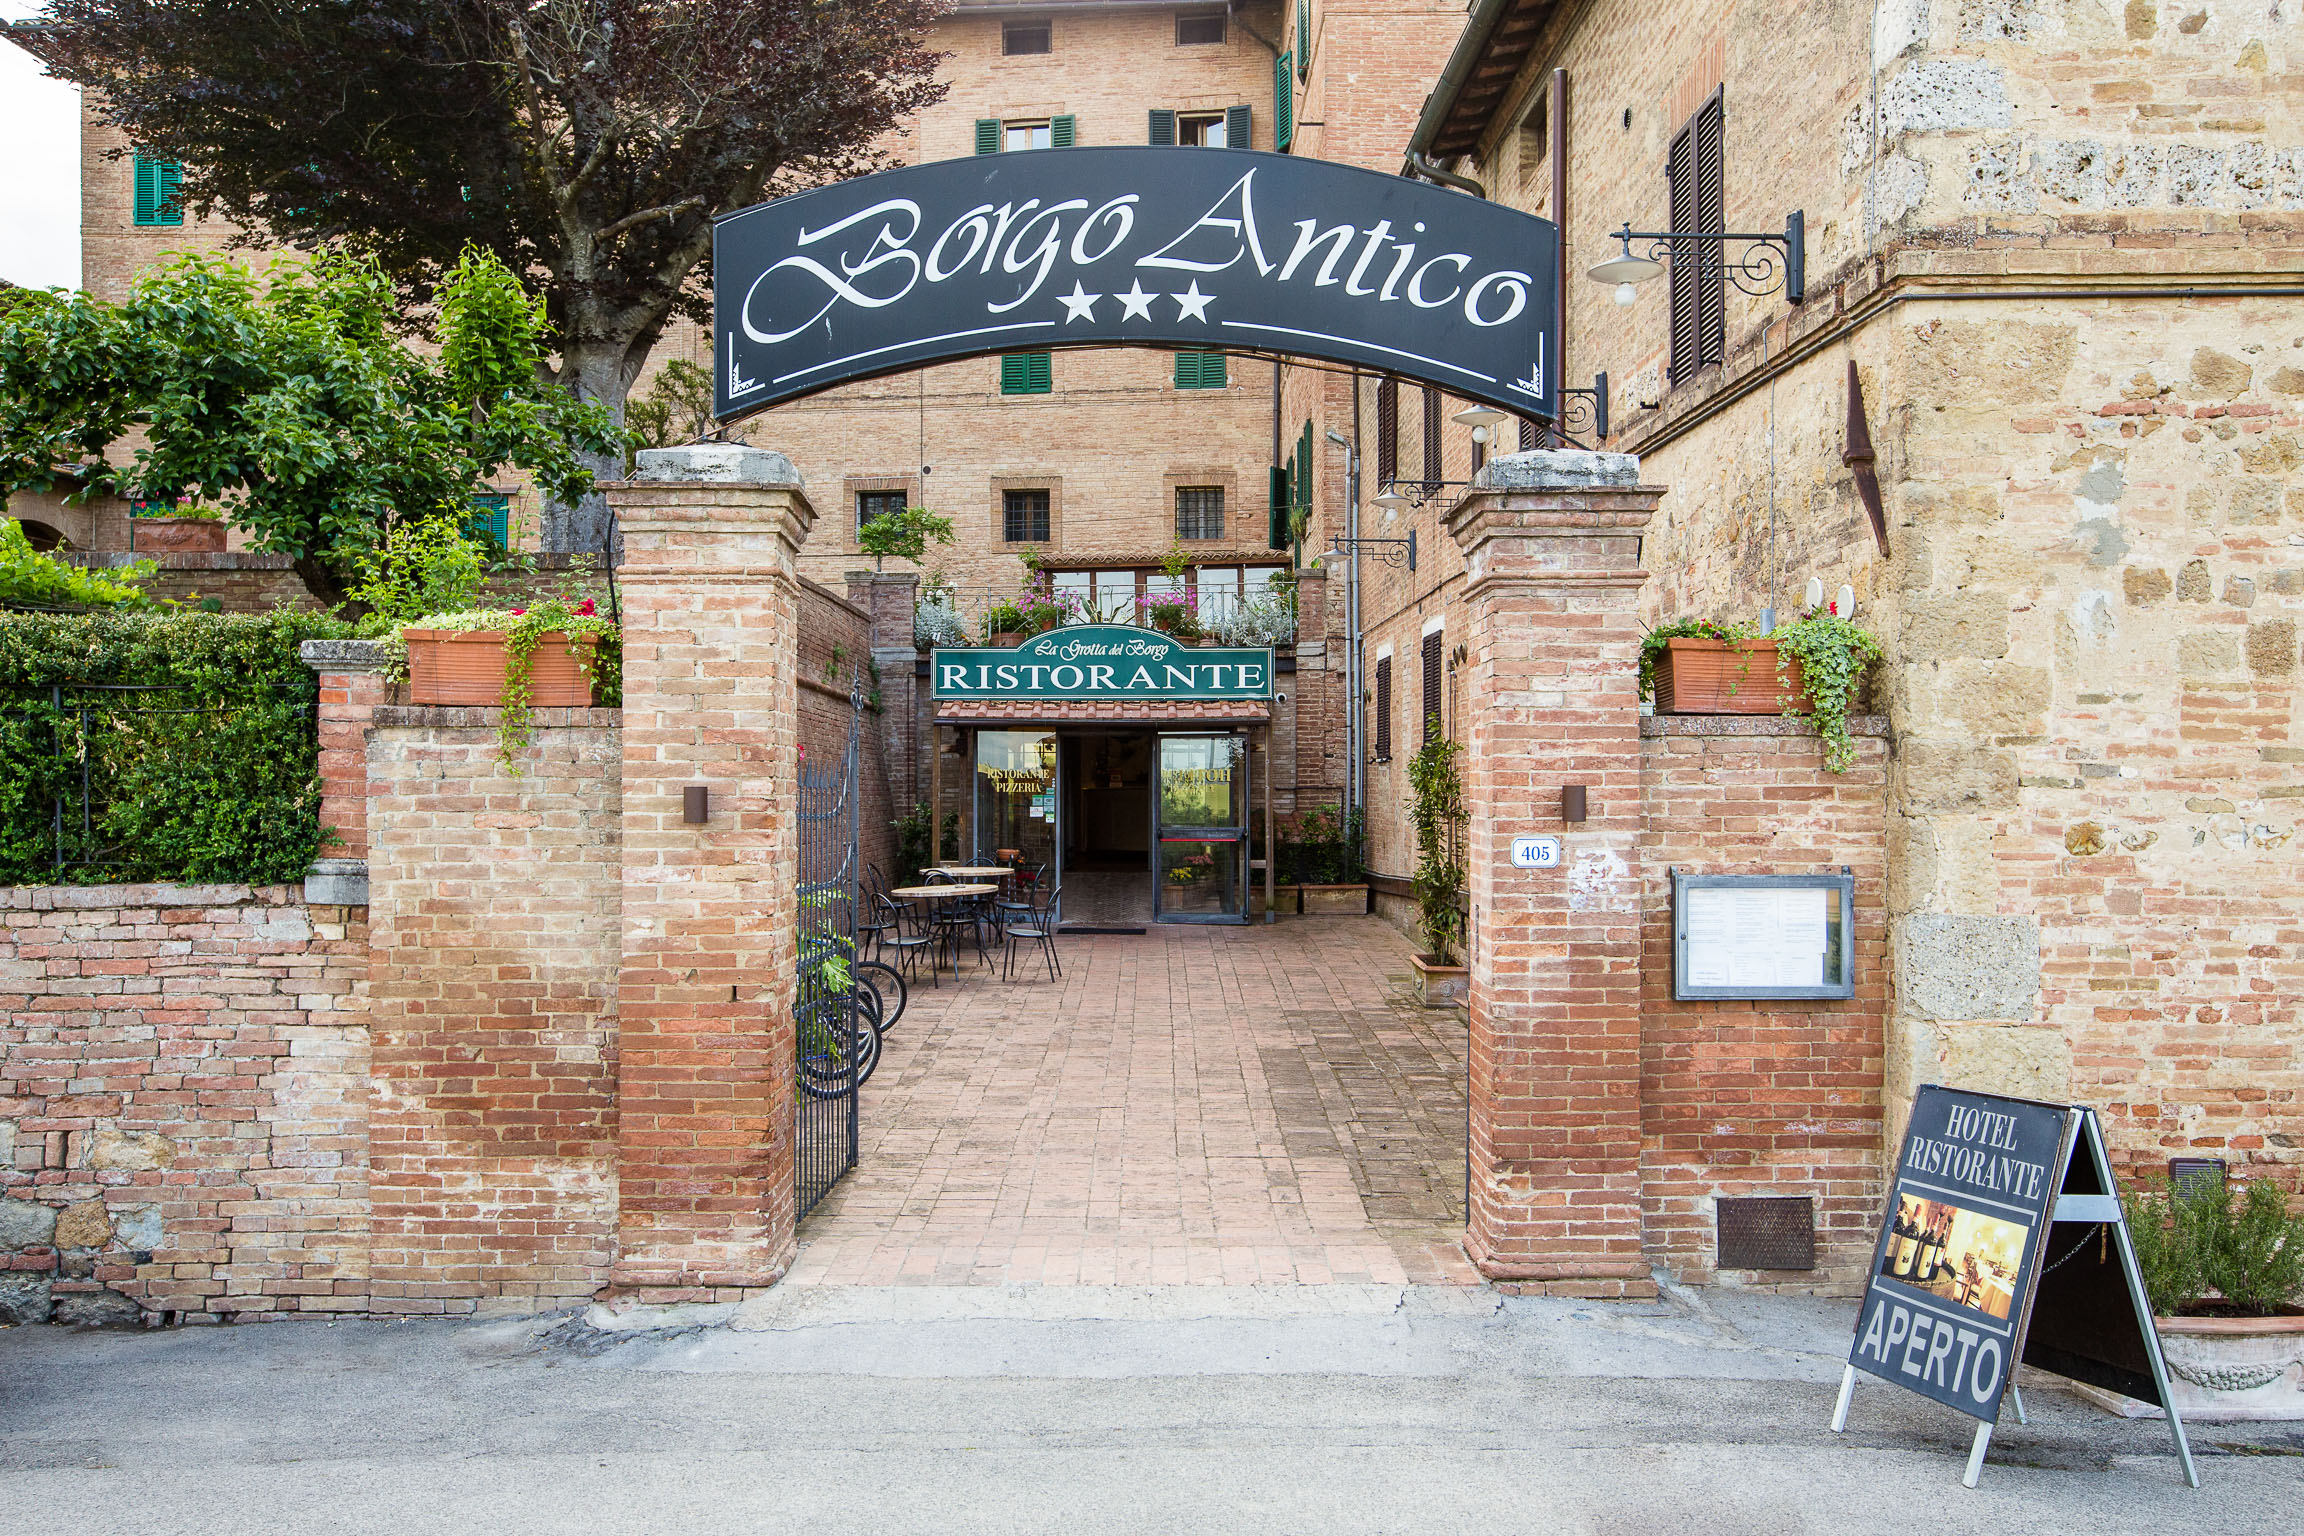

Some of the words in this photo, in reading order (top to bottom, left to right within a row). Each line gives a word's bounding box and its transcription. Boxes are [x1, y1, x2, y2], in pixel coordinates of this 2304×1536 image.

[741, 193, 1140, 344] Borgo
[1134, 166, 1533, 328] Antico
[1034, 639, 1059, 656] La
[1059, 639, 1109, 662] Grotta
[1108, 644, 1124, 656] del
[1125, 639, 1170, 662] Borgo
[939, 664, 1266, 690] RISTORANTE
[995, 782, 1042, 793] PIZZERIA
[1521, 845, 1550, 861] 405
[1944, 1104, 2018, 1151] HOTEL
[1905, 1135, 2045, 1200] RISTORANTE
[1858, 1299, 2002, 1404] APERTO
